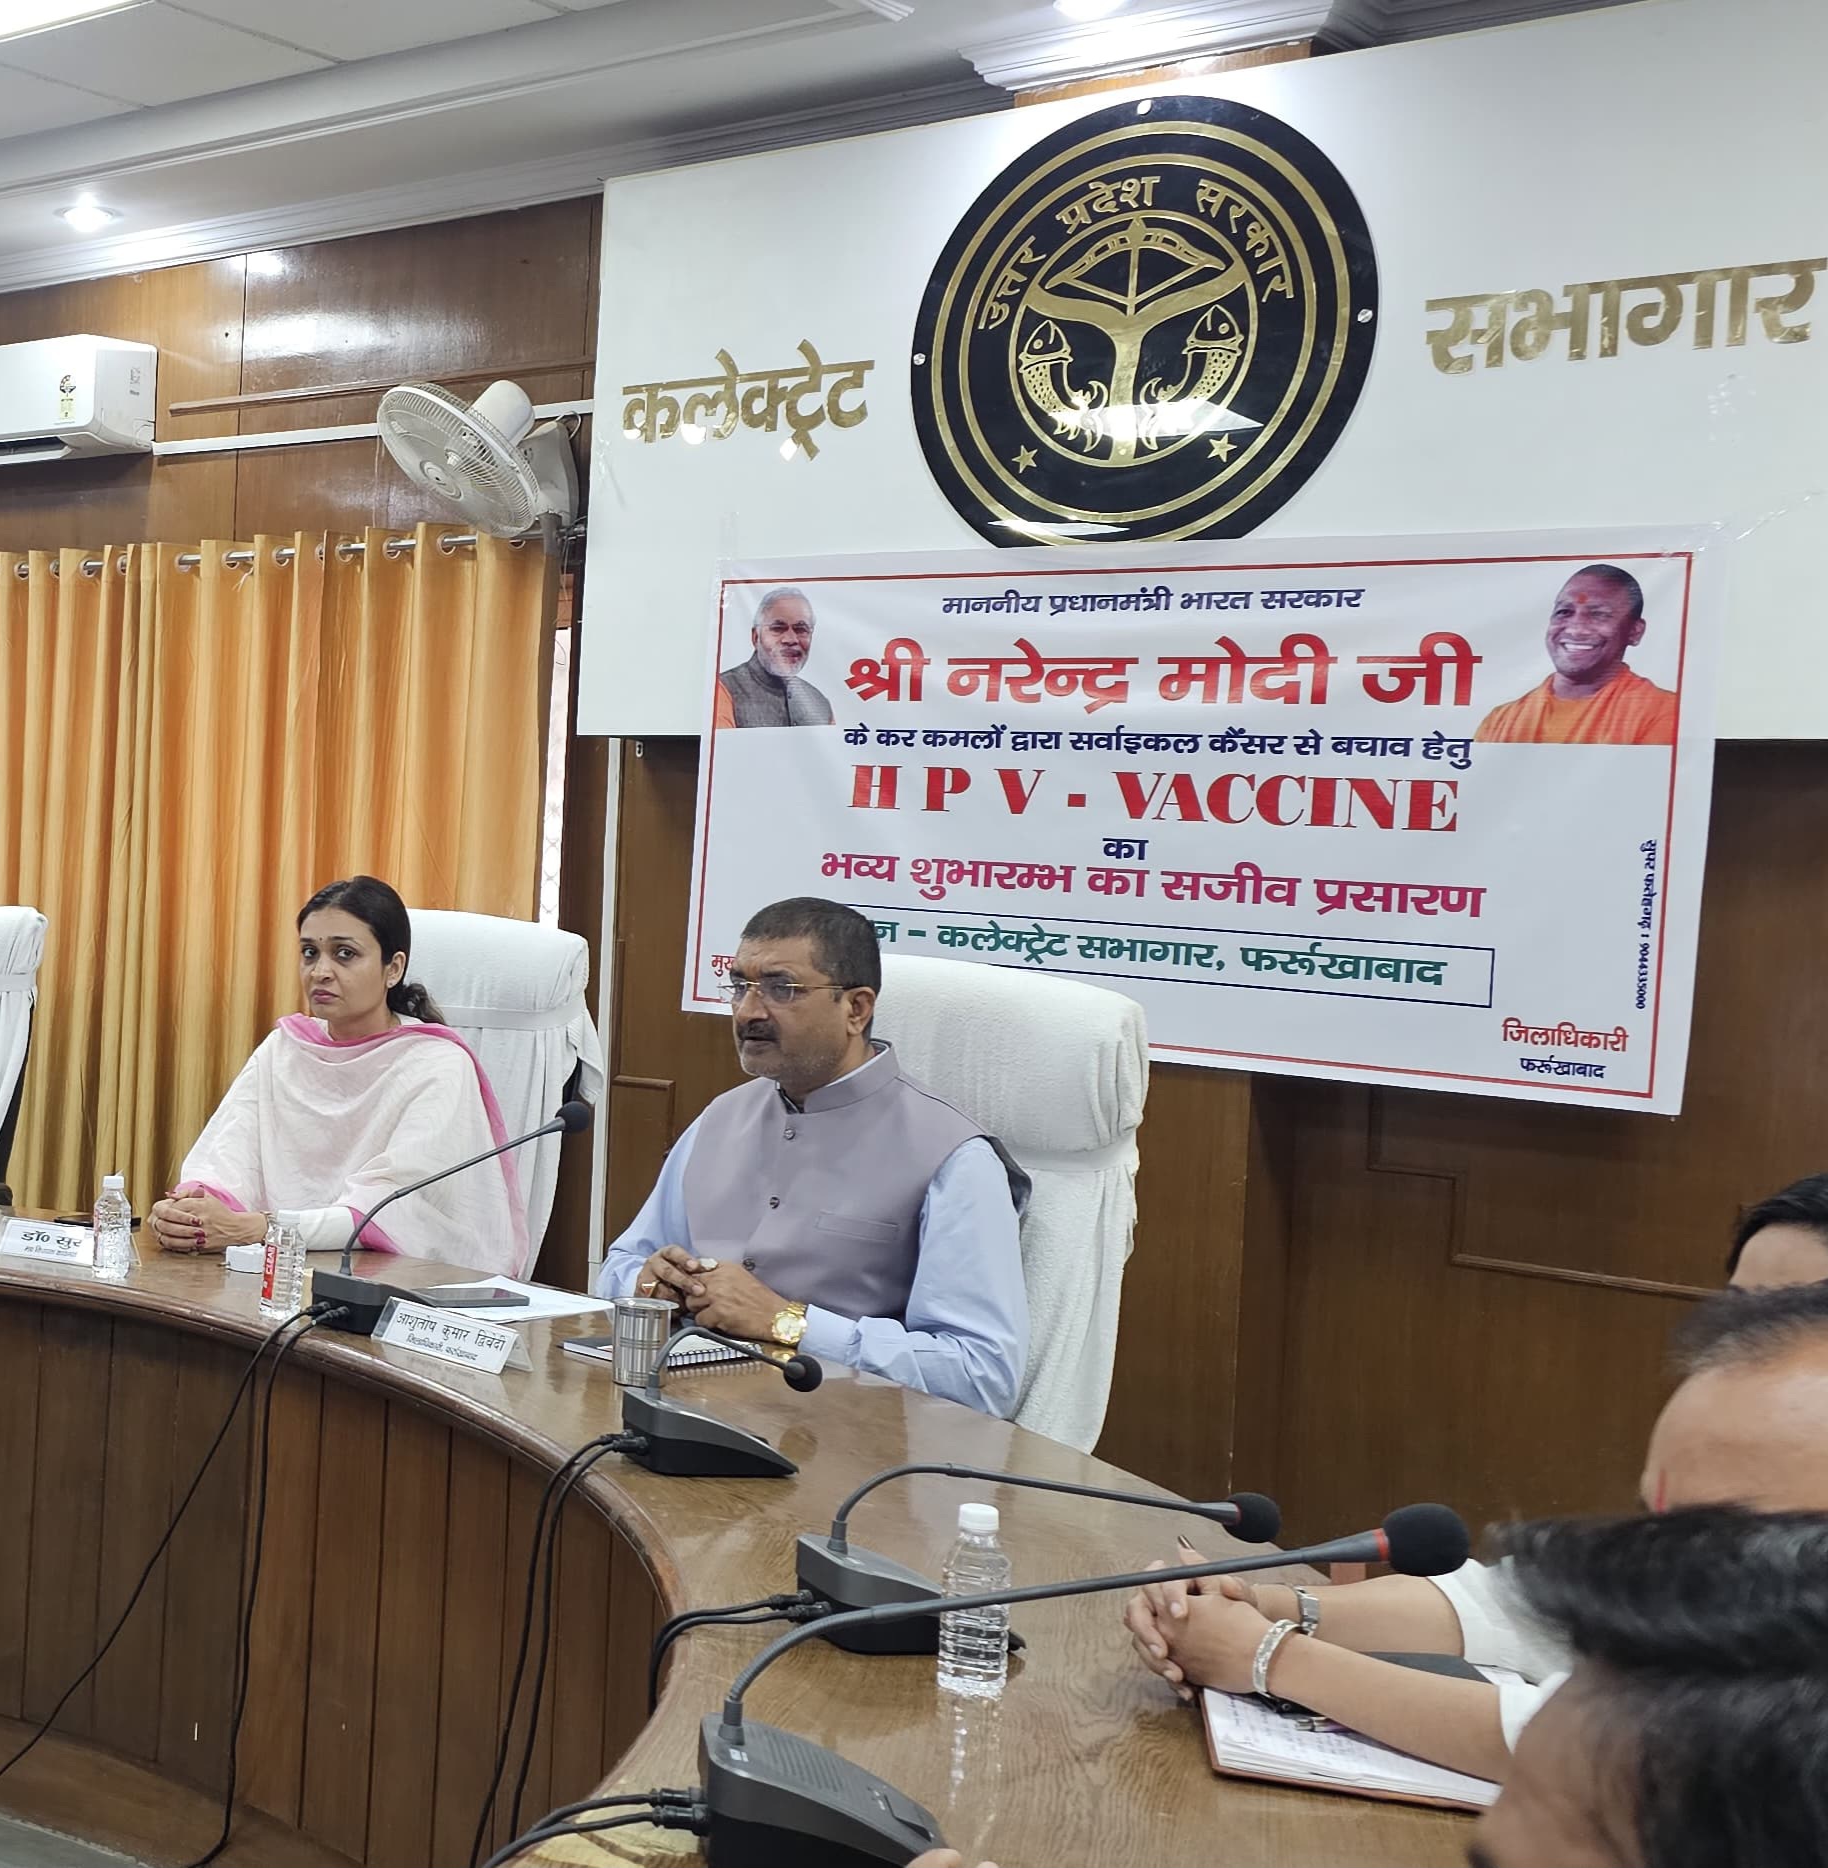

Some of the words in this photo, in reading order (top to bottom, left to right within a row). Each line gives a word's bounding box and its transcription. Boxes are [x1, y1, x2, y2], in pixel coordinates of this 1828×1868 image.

[978, 236, 1047, 330] उत्तर
[1056, 176, 1161, 234] प्रदेश
[1196, 178, 1294, 303] सरकार
[622, 339, 875, 461] कलेक्ट्रेट
[1425, 257, 1827, 375] सभागार
[942, 589, 1040, 615] माननीय
[1049, 586, 1173, 616] प्रधानमंत्री
[1180, 590, 1257, 612] भारत
[1261, 588, 1366, 611] सरकार
[844, 637, 930, 703] श्री
[947, 637, 1139, 714] नरेन्द्र
[1157, 633, 1338, 706] मोदी
[1356, 631, 1482, 708] जी
[844, 723, 868, 747] के
[876, 728, 918, 748] कर
[922, 724, 1008, 750] कमलों
[1011, 730, 1062, 753] द्वारा
[1069, 724, 1203, 755] सर्वाइकल
[1208, 727, 1289, 756] कैंसर
[1293, 728, 1322, 756] से
[1331, 736, 1413, 758] बचाव
[1422, 730, 1475, 770] हेतु
[847, 765, 902, 811] H
[921, 766, 972, 813] P
[994, 768, 1047, 815] V
[1112, 771, 1459, 833] VACCINE
[1102, 836, 1149, 861] का
[821, 851, 900, 882] भव्य
[910, 855, 1076, 900] शुभारम्भ
[1087, 865, 1150, 897] का
[1161, 861, 1301, 908] सजीव
[1314, 877, 1487, 918] प्रसारण
[937, 919, 1068, 965] कलेक्ट्रेट
[1077, 934, 1226, 972] सभागार,
[1501, 1016, 1629, 1053] जिलाधिकारी
[265, 1246, 276, 1276] CLEAR
[442, 1323, 471, 1342] कुमार
